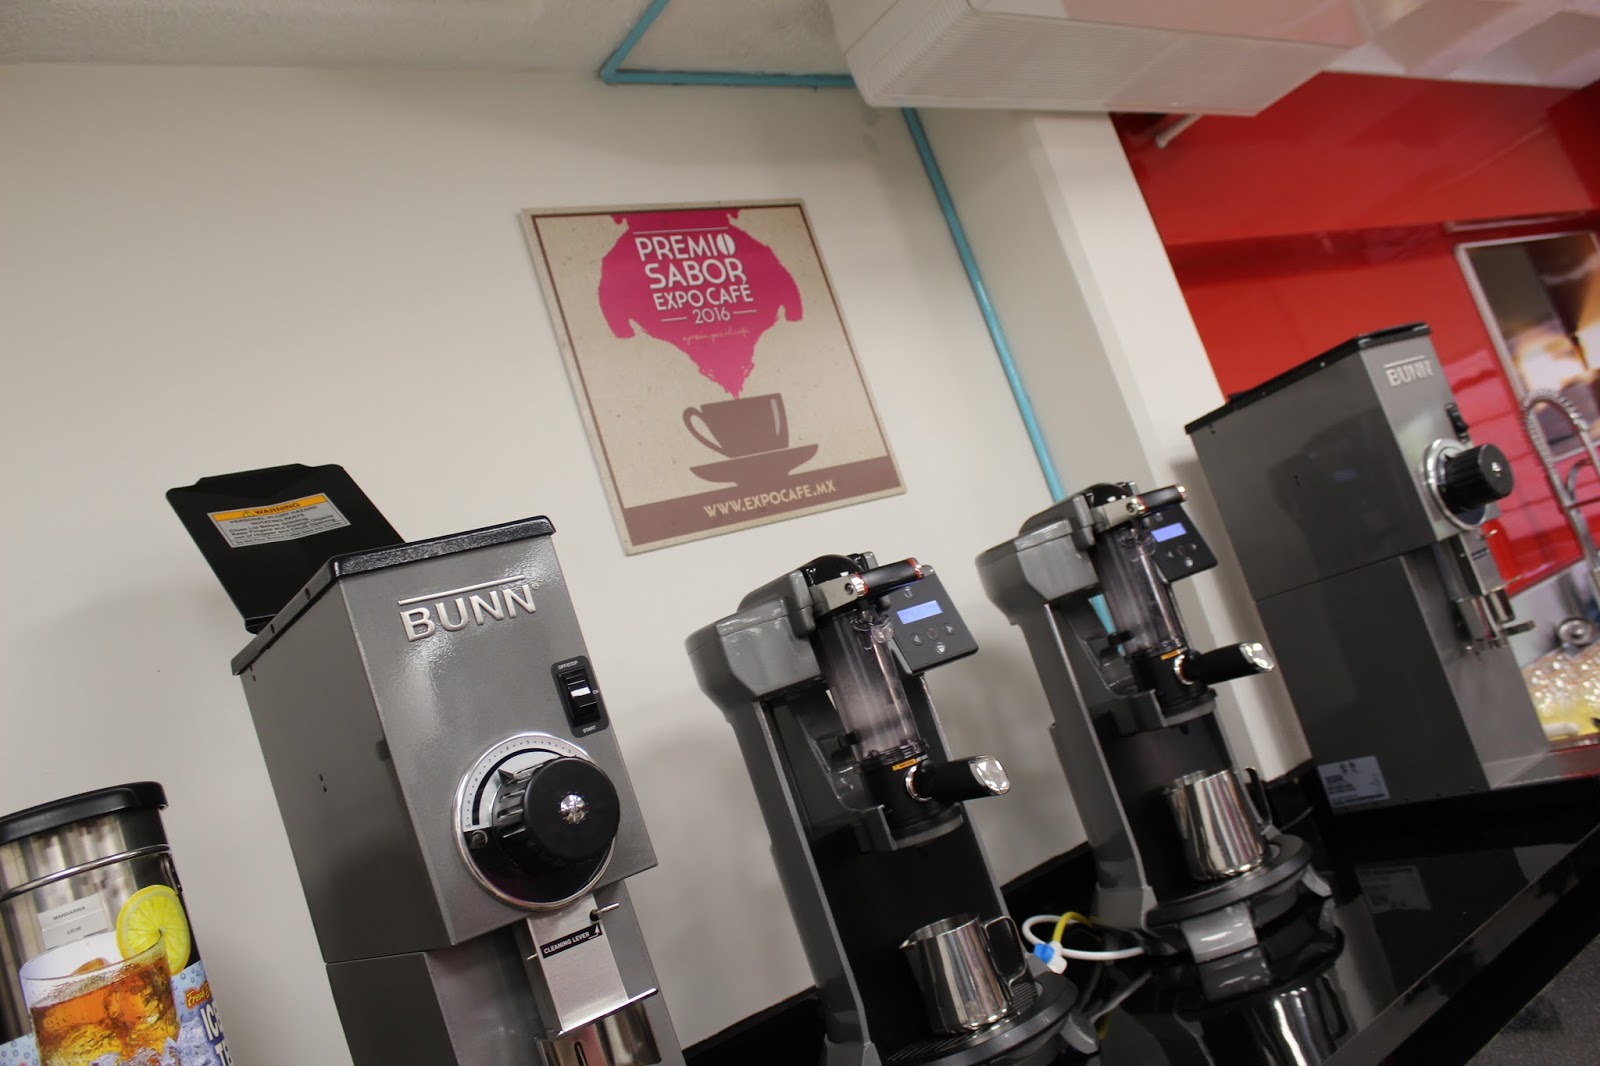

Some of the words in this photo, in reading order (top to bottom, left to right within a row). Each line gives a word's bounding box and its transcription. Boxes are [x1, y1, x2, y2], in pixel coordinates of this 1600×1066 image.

[635, 233, 735, 262] PREMIO
[644, 258, 747, 289] SABOR
[652, 290, 702, 311] EXPO
[692, 307, 731, 324] 2016
[254, 502, 301, 515] WARNING
[703, 480, 836, 518] WWW.EXPOCAFE.MX
[400, 584, 537, 642] BUNN
[582, 725, 597, 733] START
[53, 905, 86, 920] MANDARINA
[543, 938, 572, 955] CLEANING
[572, 931, 590, 942] LEVER
